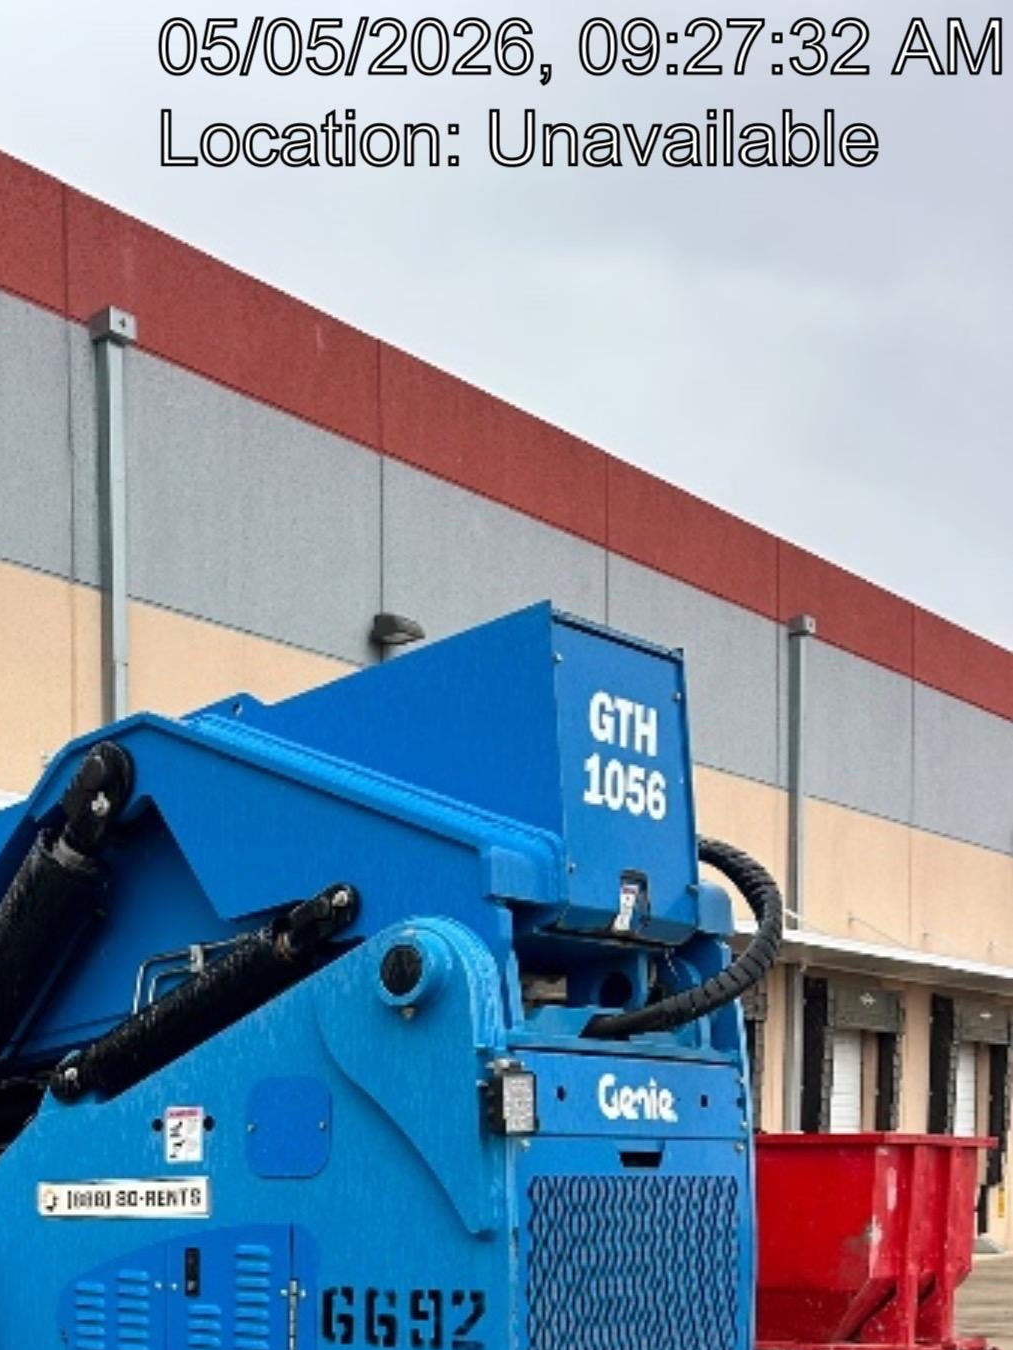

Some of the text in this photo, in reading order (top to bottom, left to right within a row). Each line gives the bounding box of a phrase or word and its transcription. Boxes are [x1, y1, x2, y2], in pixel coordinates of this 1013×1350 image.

[589, 689, 658, 757] GTH
[583, 752, 667, 821] 1056
[598, 1073, 678, 1122] Genie
